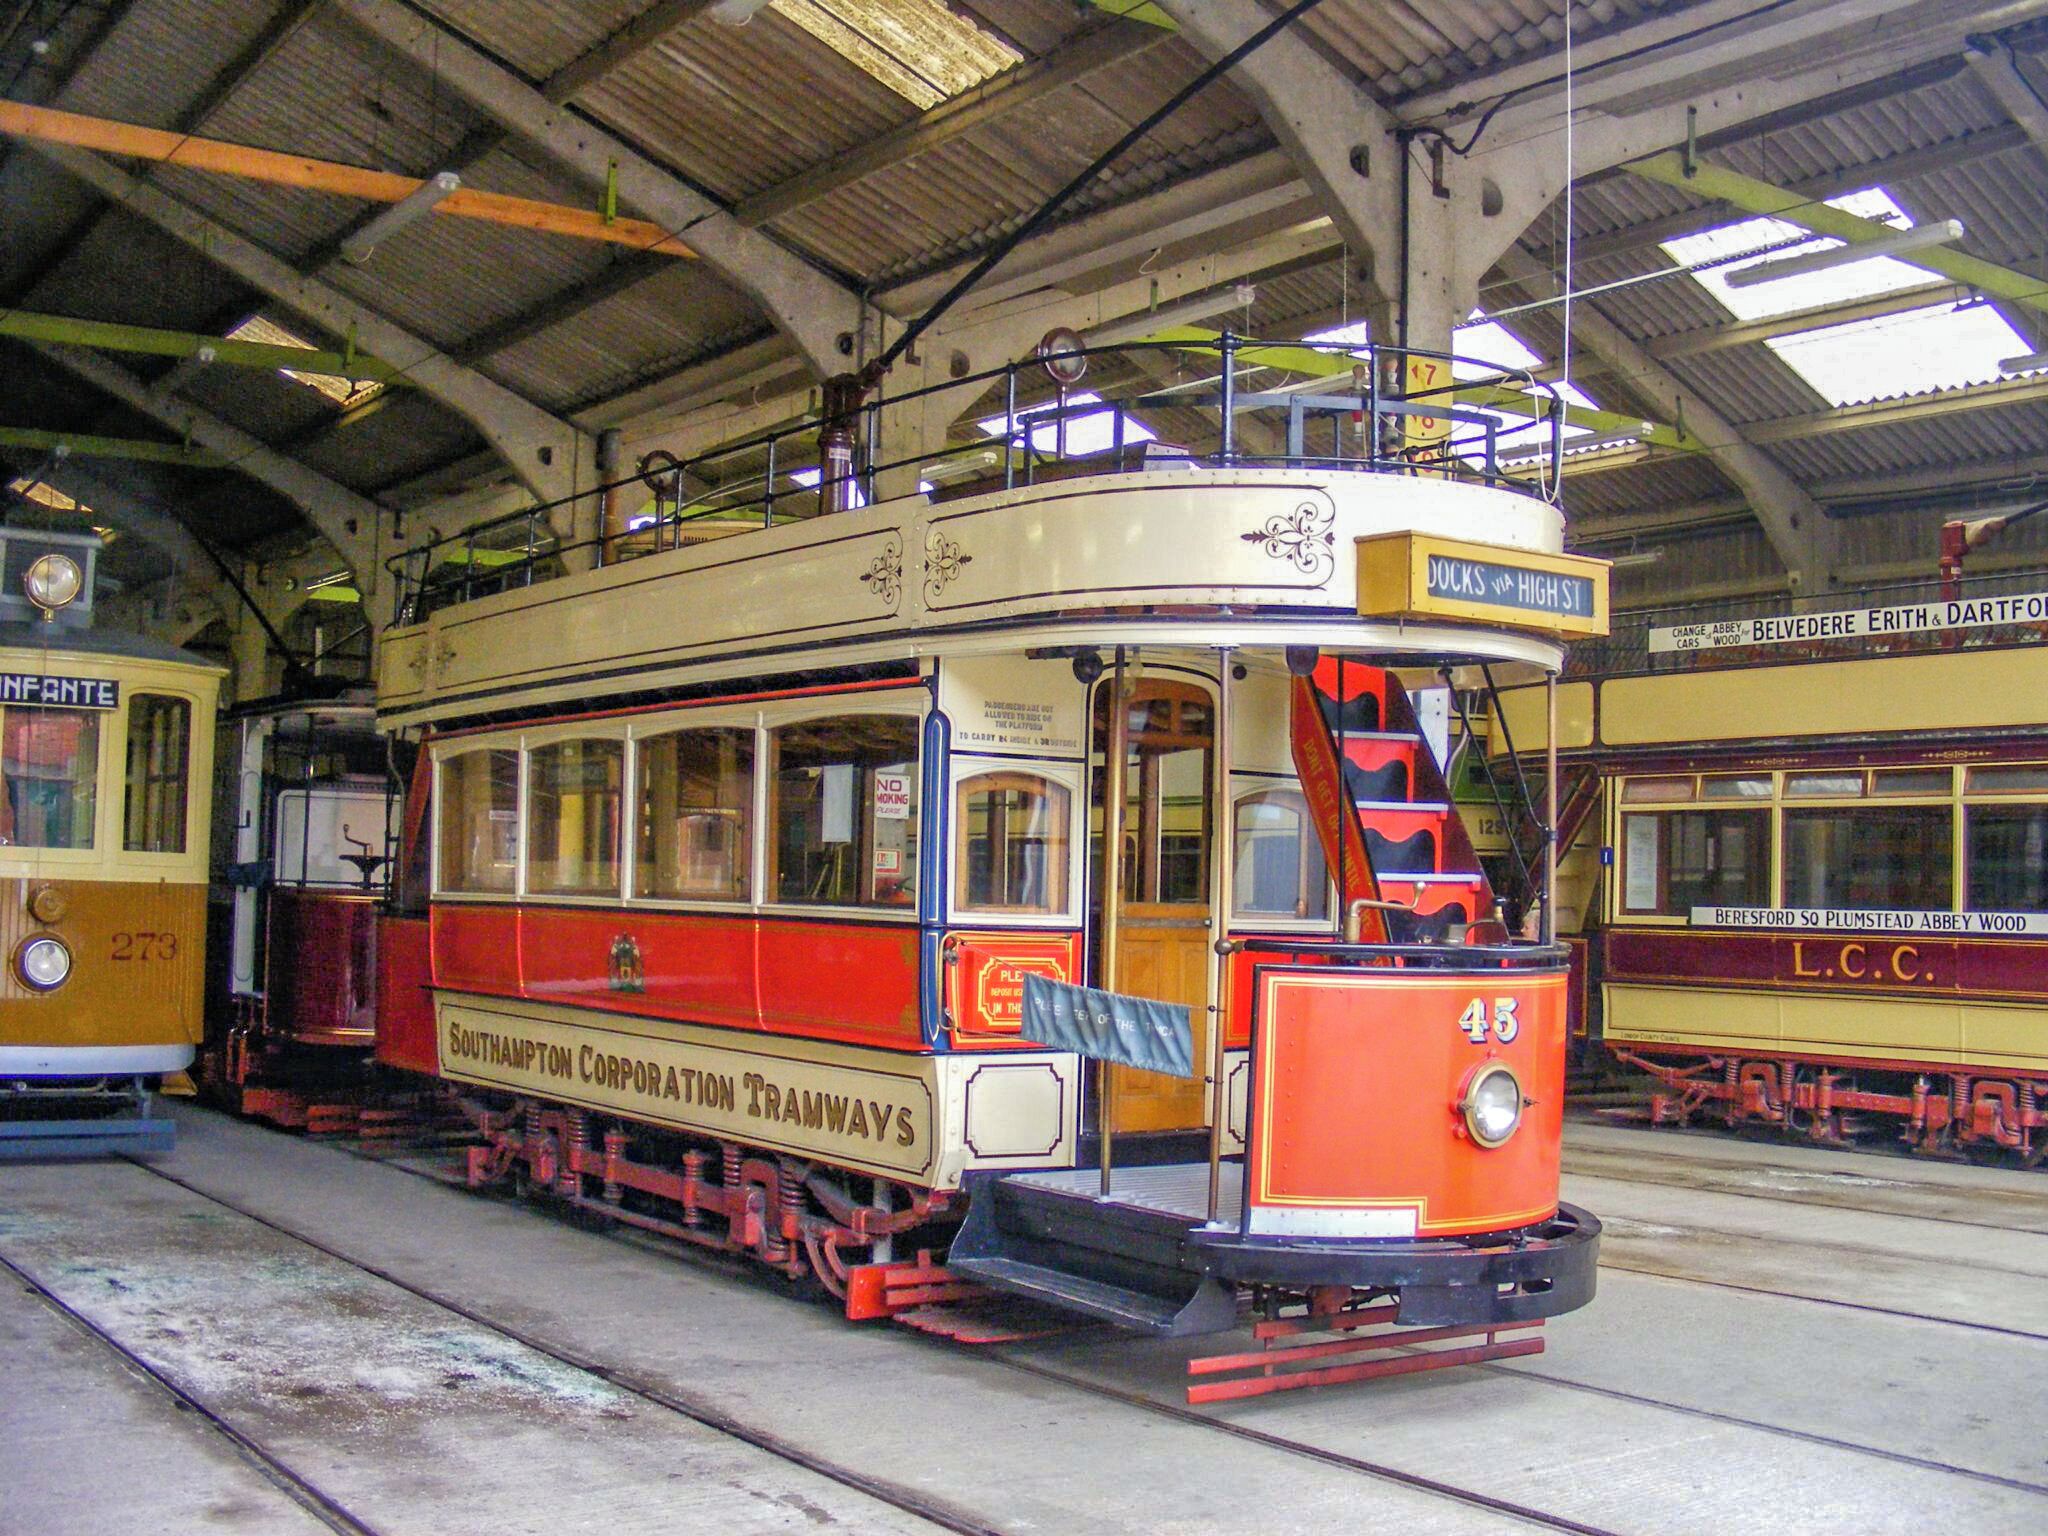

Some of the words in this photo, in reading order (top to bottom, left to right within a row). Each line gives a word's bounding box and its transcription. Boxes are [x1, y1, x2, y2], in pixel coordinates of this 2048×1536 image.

[1424, 363, 1437, 386] 7
[1491, 573, 1515, 596] VIA
[1518, 571, 1559, 608] HIGH
[1561, 579, 1582, 611] ST
[1752, 613, 1857, 642] BELVEDERE
[1868, 607, 1928, 632] ERITH
[1931, 613, 1942, 627] &
[1946, 596, 2048, 626] DARTFO
[1672, 624, 1706, 638] CHANGE
[1712, 622, 1742, 635] ABBEY
[1676, 637, 1700, 649] CARS
[1713, 634, 1741, 647] WOOD
[959, 732, 969, 740] TO
[971, 733, 995, 742] CARRY
[877, 779, 902, 793] NO
[1715, 908, 1795, 926] BERESFORD
[1800, 910, 1820, 926] SQ
[1826, 910, 1914, 928] PLUMSTEAD
[1920, 912, 1972, 930] ABBEY
[1979, 913, 2027, 931] WOOD
[111, 932, 177, 961] 273
[993, 1003, 1002, 1013] IN
[1114, 1018, 1136, 1032] THE
[1458, 997, 1520, 1045] 45
[449, 1021, 573, 1080] SOUTHAMPTON
[578, 1044, 735, 1112] CORPORATION
[743, 1071, 915, 1147] TRAMWAYS
